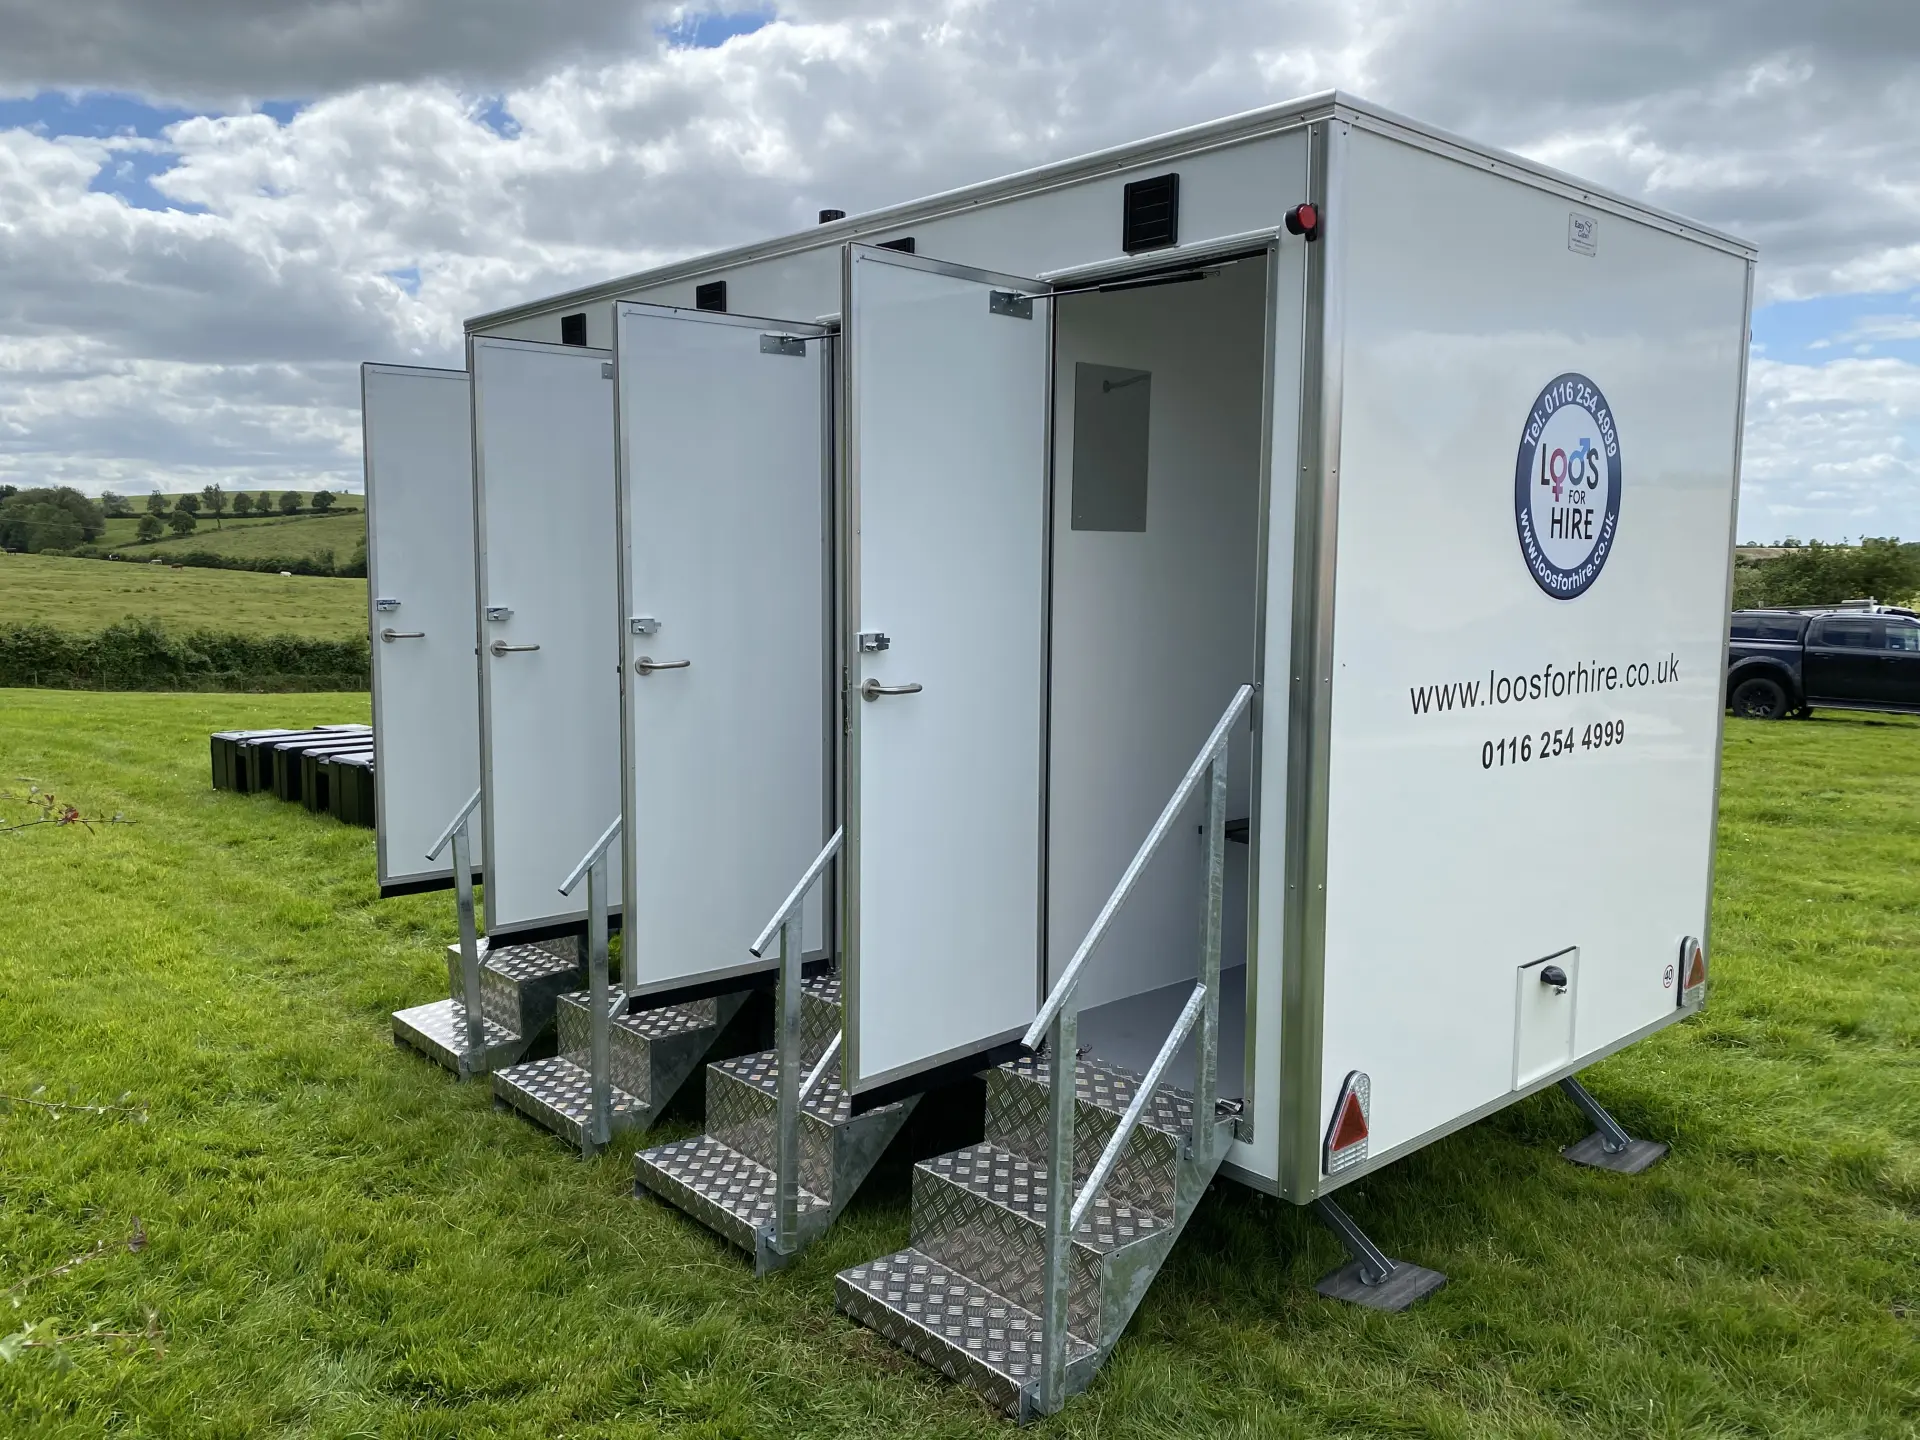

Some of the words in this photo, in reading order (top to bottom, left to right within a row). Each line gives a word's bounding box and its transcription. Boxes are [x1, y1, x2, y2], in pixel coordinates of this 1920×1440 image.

[1524, 410, 1546, 448] Tel:
[1545, 381, 1574, 414] 0116
[1576, 383, 1598, 413] 254
[1597, 408, 1617, 458] 4999
[1540, 437, 1599, 502] LOOS
[1568, 489, 1586, 505] FOR
[1519, 507, 1615, 591] www.loosforhire.co.uk
[1550, 506, 1594, 540] HIRE
[1410, 652, 1680, 715] www.loosforhire.co.uk
[1482, 734, 1532, 769] 0116
[1539, 726, 1575, 759] 254
[1581, 719, 1625, 750] 4999
